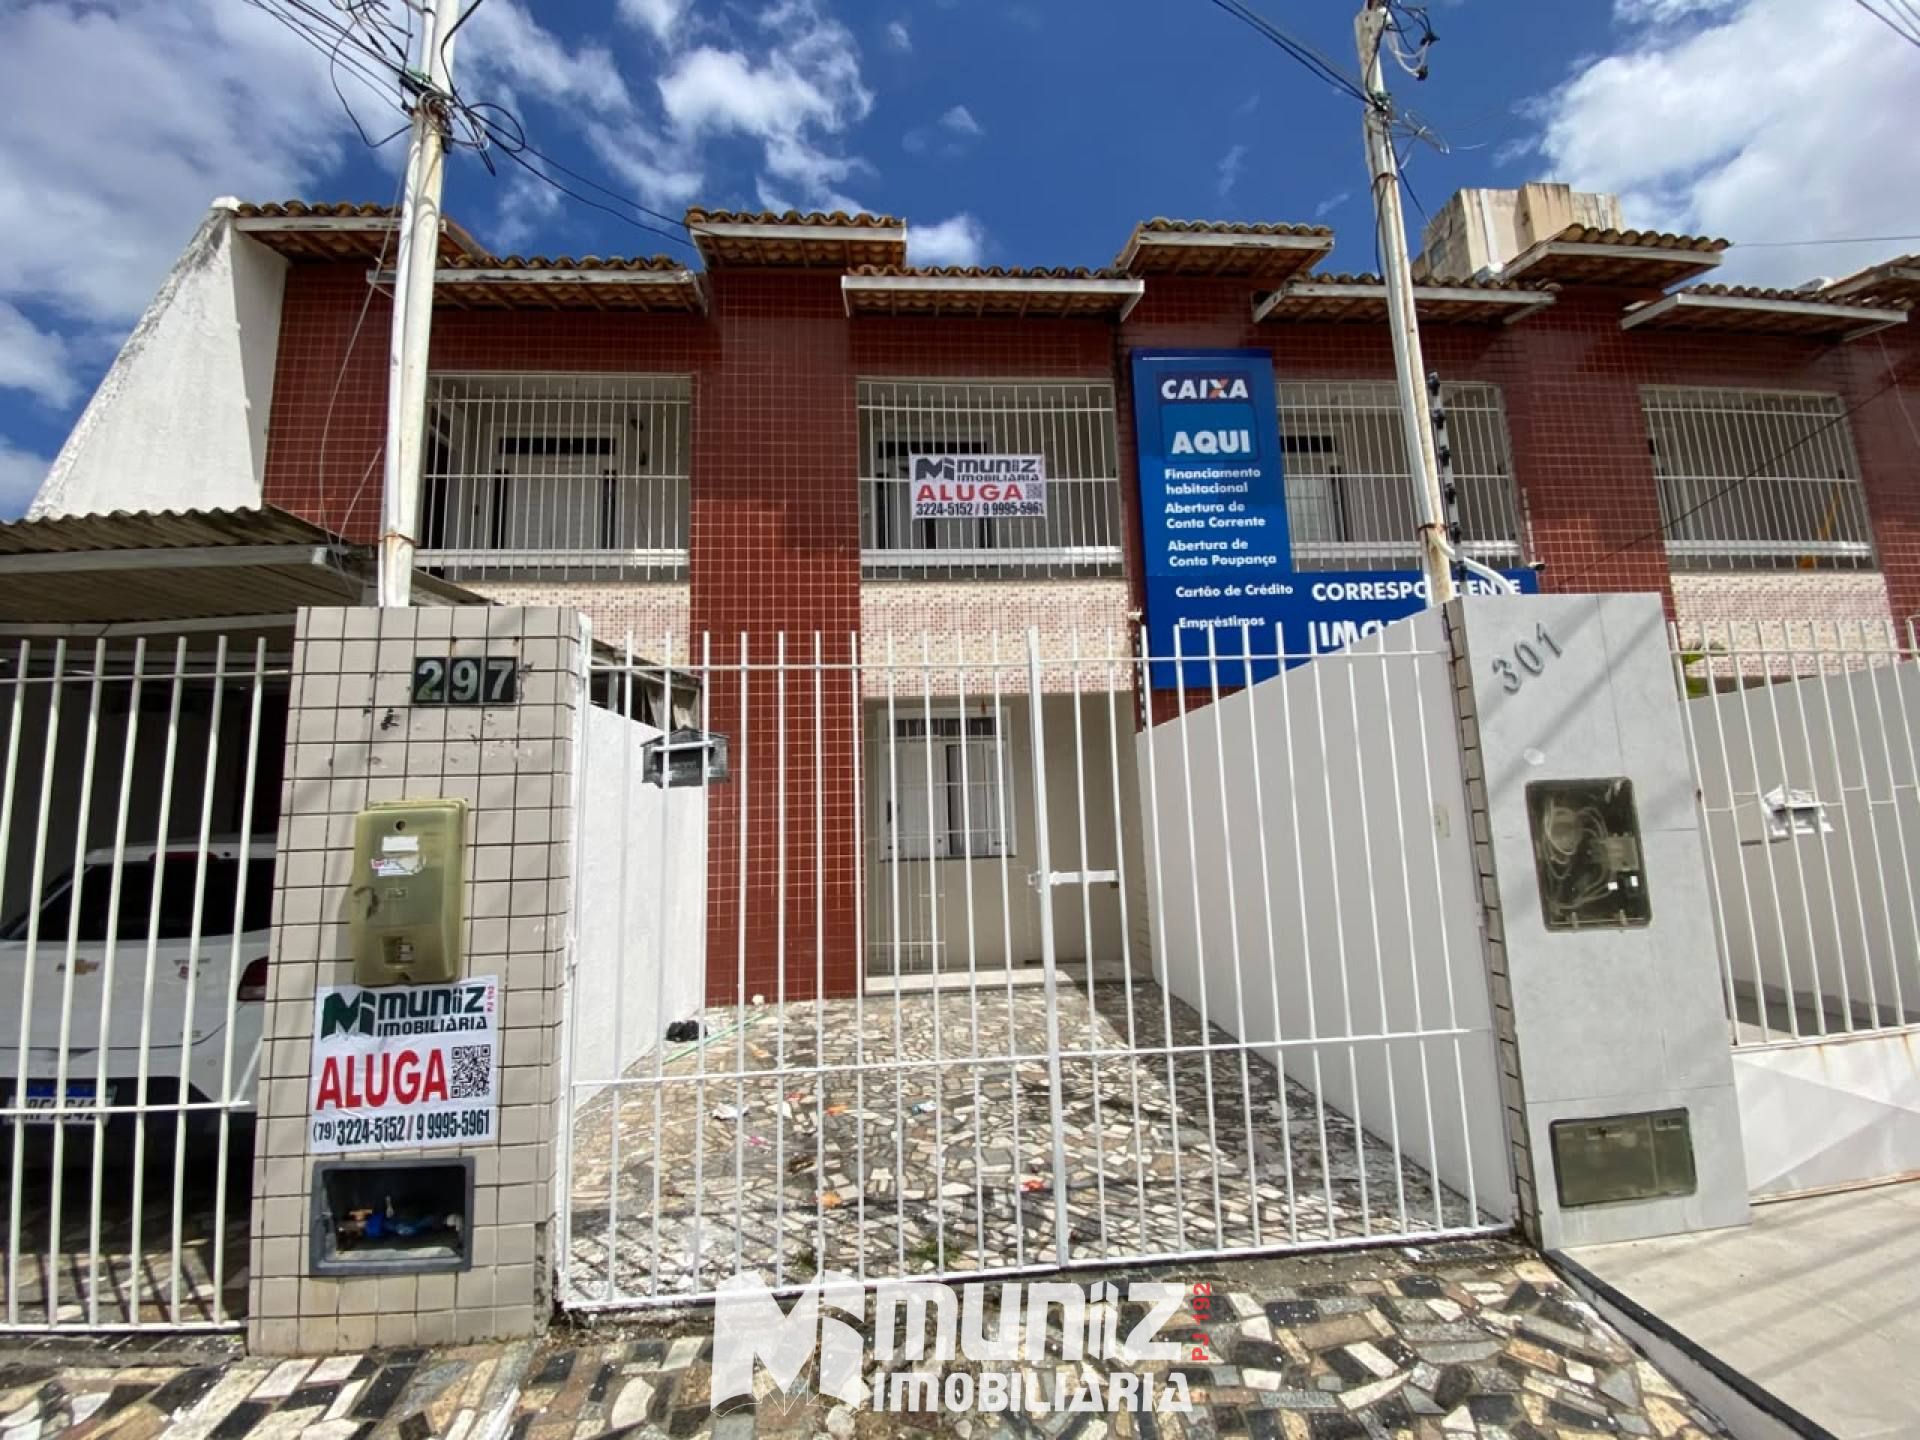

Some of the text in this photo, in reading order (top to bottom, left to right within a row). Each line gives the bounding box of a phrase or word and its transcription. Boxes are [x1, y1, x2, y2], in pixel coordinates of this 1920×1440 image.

[1161, 378, 1249, 400] CAIXA
[1171, 430, 1251, 455] AQUI
[1164, 468, 1261, 480] Financiamento
[916, 484, 1023, 501] ALUGA
[1166, 482, 1249, 495] habitacional
[916, 502, 973, 515] 3224-5152
[1165, 501, 1246, 514] Abertura de
[1166, 516, 1266, 529] Conta Corrente
[1168, 538, 1249, 551] Abertura de
[1169, 554, 1278, 567] Conta Poupança
[1175, 583, 1294, 598] Cartão de Crédito
[1179, 615, 1266, 630] Empréstimos
[1491, 621, 1563, 695] 301
[416, 659, 514, 701] 297
[315, 1048, 449, 1110] ALUGA
[313, 1120, 336, 1142] (79)
[337, 1116, 405, 1146] 3224-5152
[416, 1113, 424, 1141] 9
[427, 1109, 490, 1138] 9995-5961
